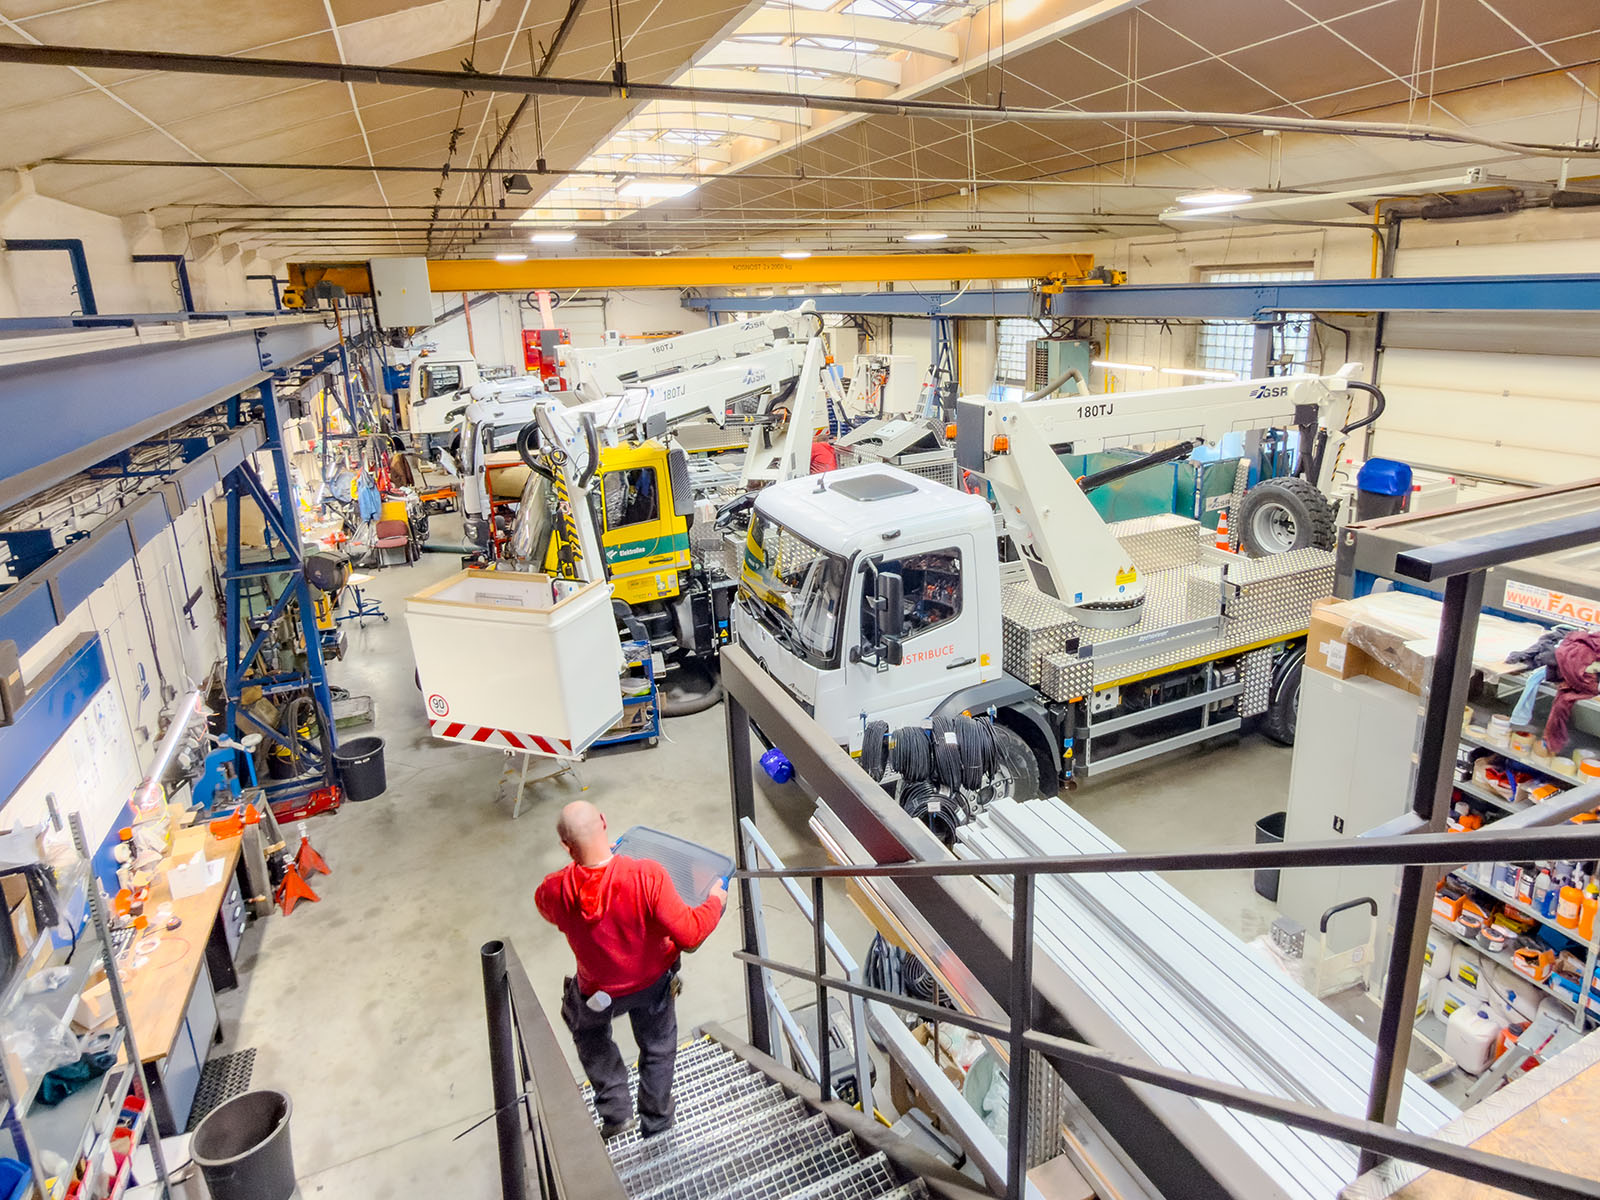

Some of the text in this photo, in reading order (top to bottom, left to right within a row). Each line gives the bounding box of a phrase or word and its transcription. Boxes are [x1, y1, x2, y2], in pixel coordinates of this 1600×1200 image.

[652, 343, 674, 354] 180TJ
[663, 384, 686, 400] 180TJ
[1262, 386, 1288, 398] GSR
[1076, 403, 1114, 418] 180TJ
[899, 644, 954, 665] ISTRIBUCE
[432, 698, 445, 710] 90
